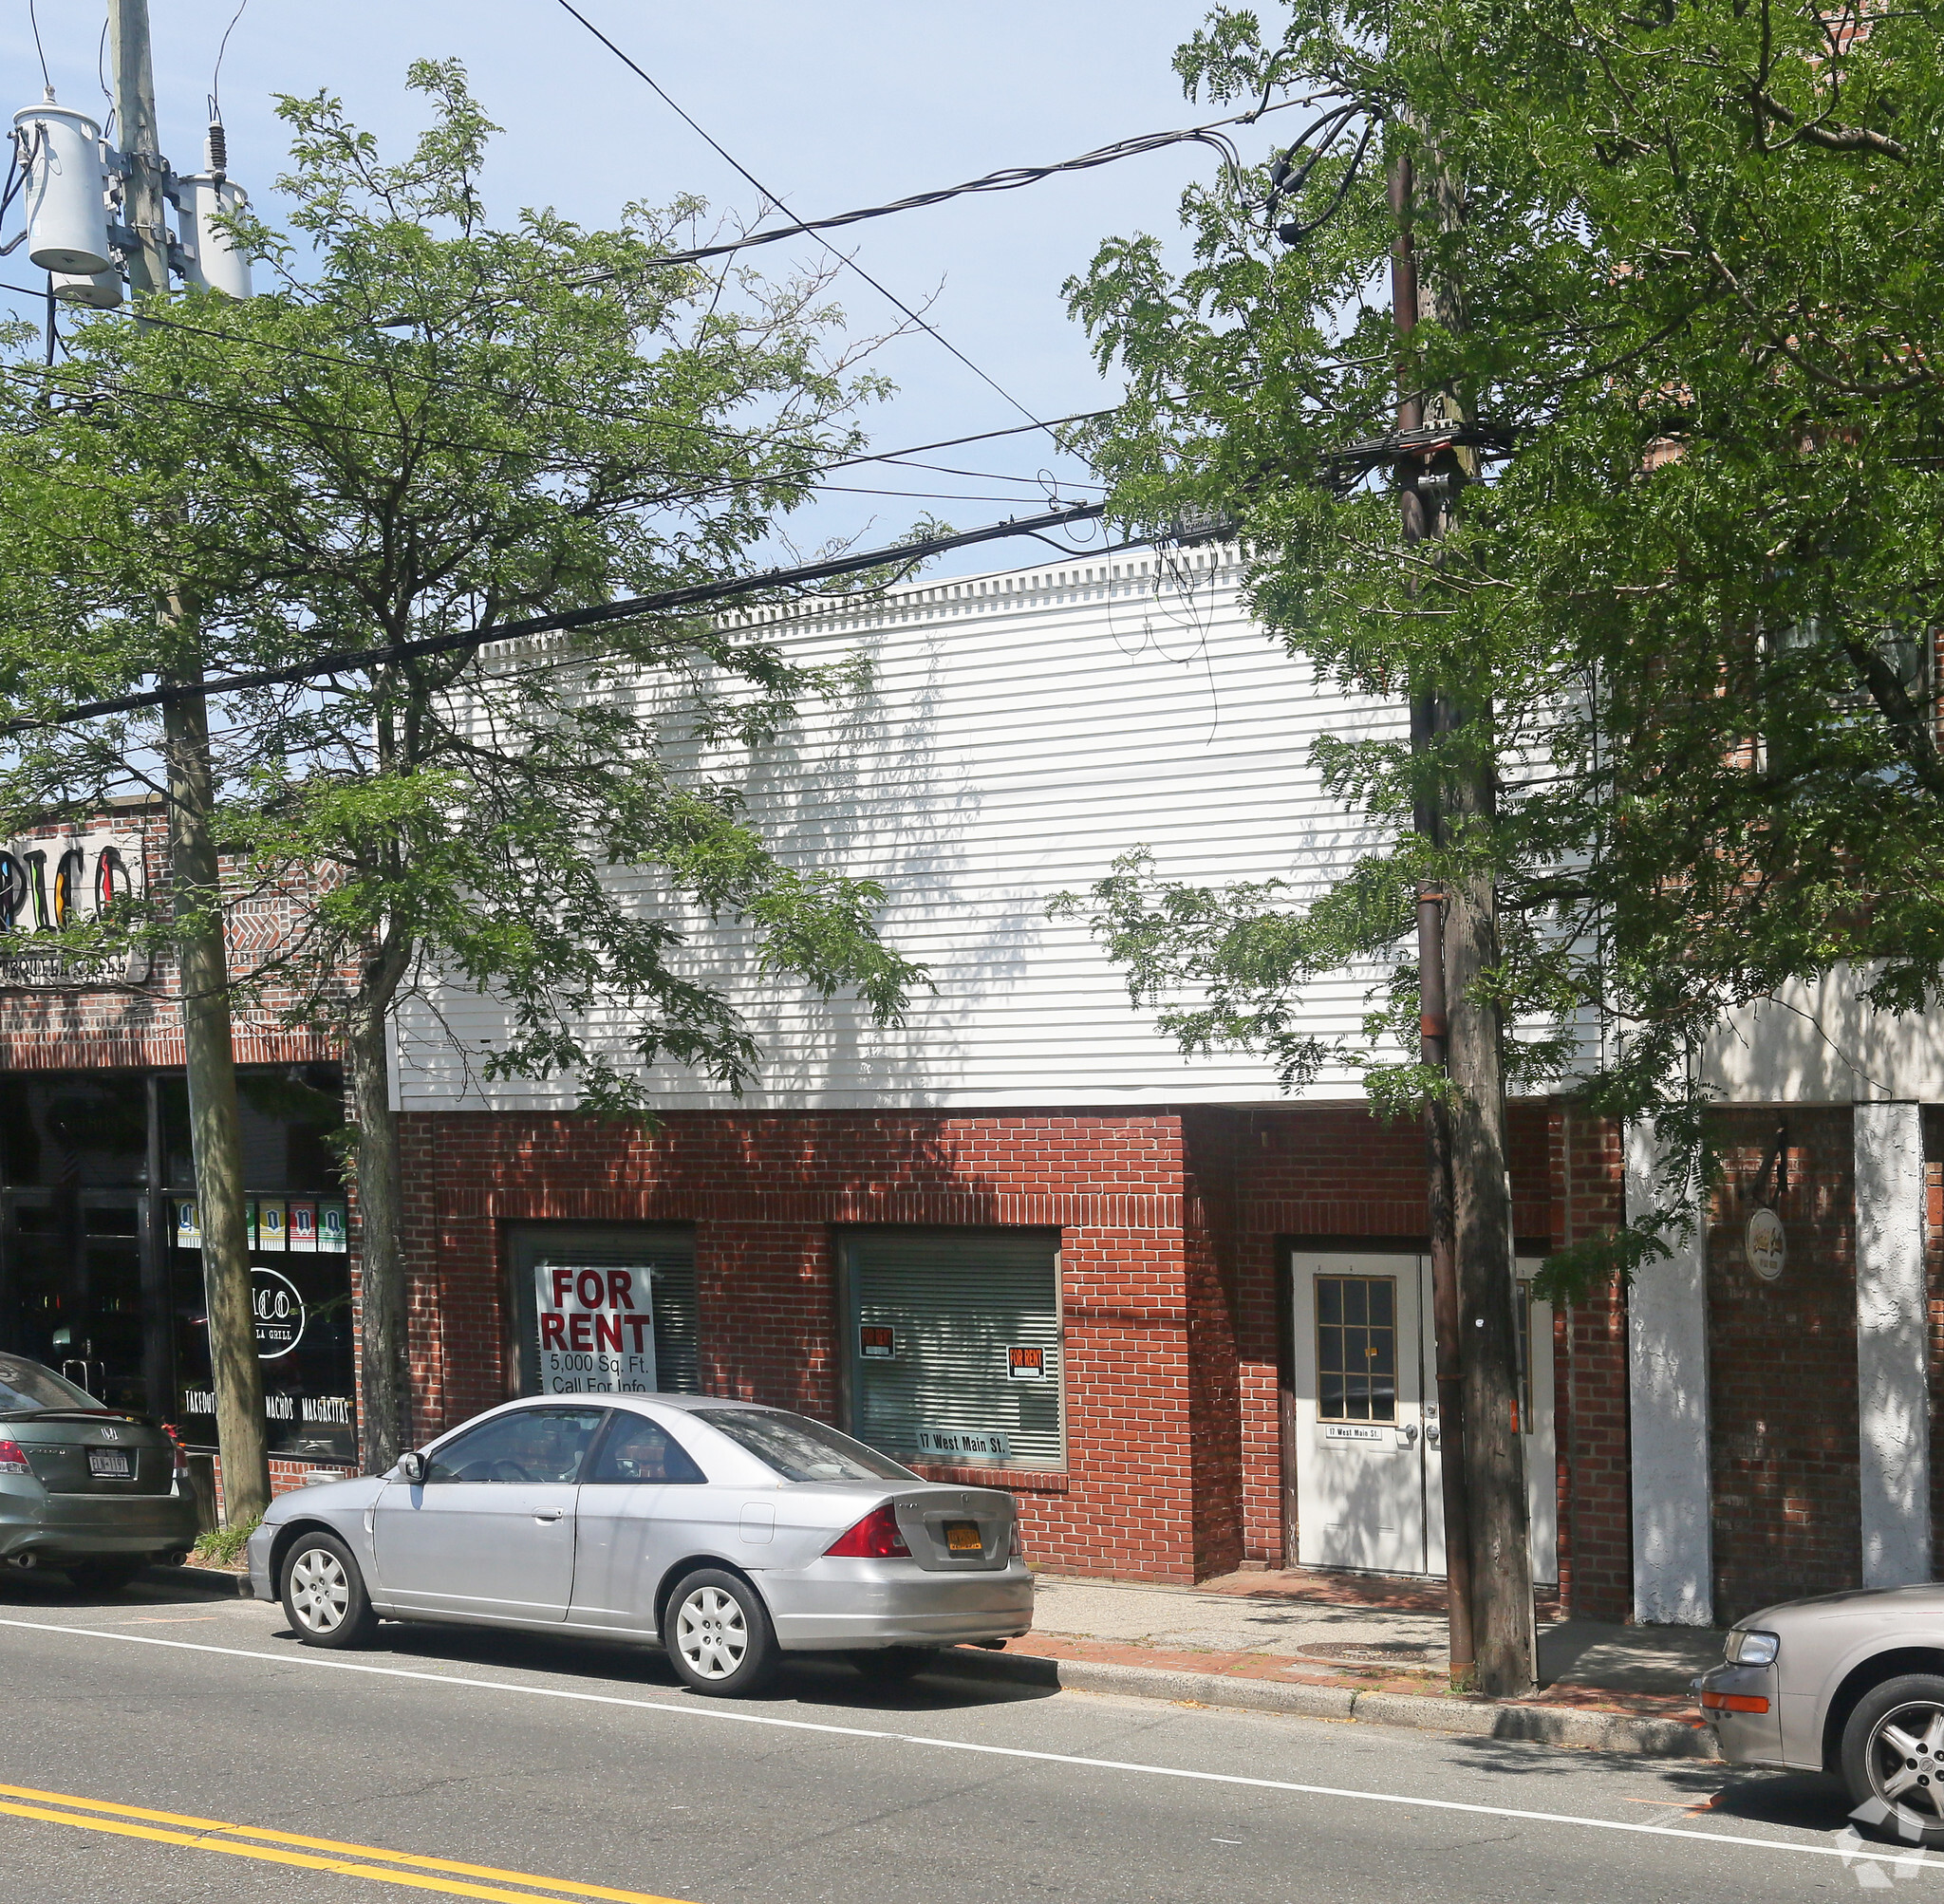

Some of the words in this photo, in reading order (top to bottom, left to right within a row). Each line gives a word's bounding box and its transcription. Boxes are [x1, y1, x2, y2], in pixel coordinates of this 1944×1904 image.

[551, 1269, 635, 1310] FOR
[252, 1287, 290, 1320] ICO
[269, 1329, 292, 1340] GRILL
[540, 1313, 650, 1353] RENT
[551, 1353, 593, 1372] 5,000
[598, 1355, 625, 1376] Sq.
[628, 1356, 649, 1373] Ft.
[1010, 1349, 1023, 1367] FOR
[1024, 1349, 1042, 1368] RENT
[552, 1376, 582, 1393] Call
[587, 1377, 612, 1392] For
[184, 1390, 215, 1414] TAKEOUT
[265, 1395, 294, 1420] NACHOS
[301, 1397, 349, 1425] MARGARITAS
[920, 1433, 929, 1448] 17
[933, 1434, 959, 1450] West
[962, 1436, 987, 1452] Main
[989, 1437, 1005, 1453] St.
